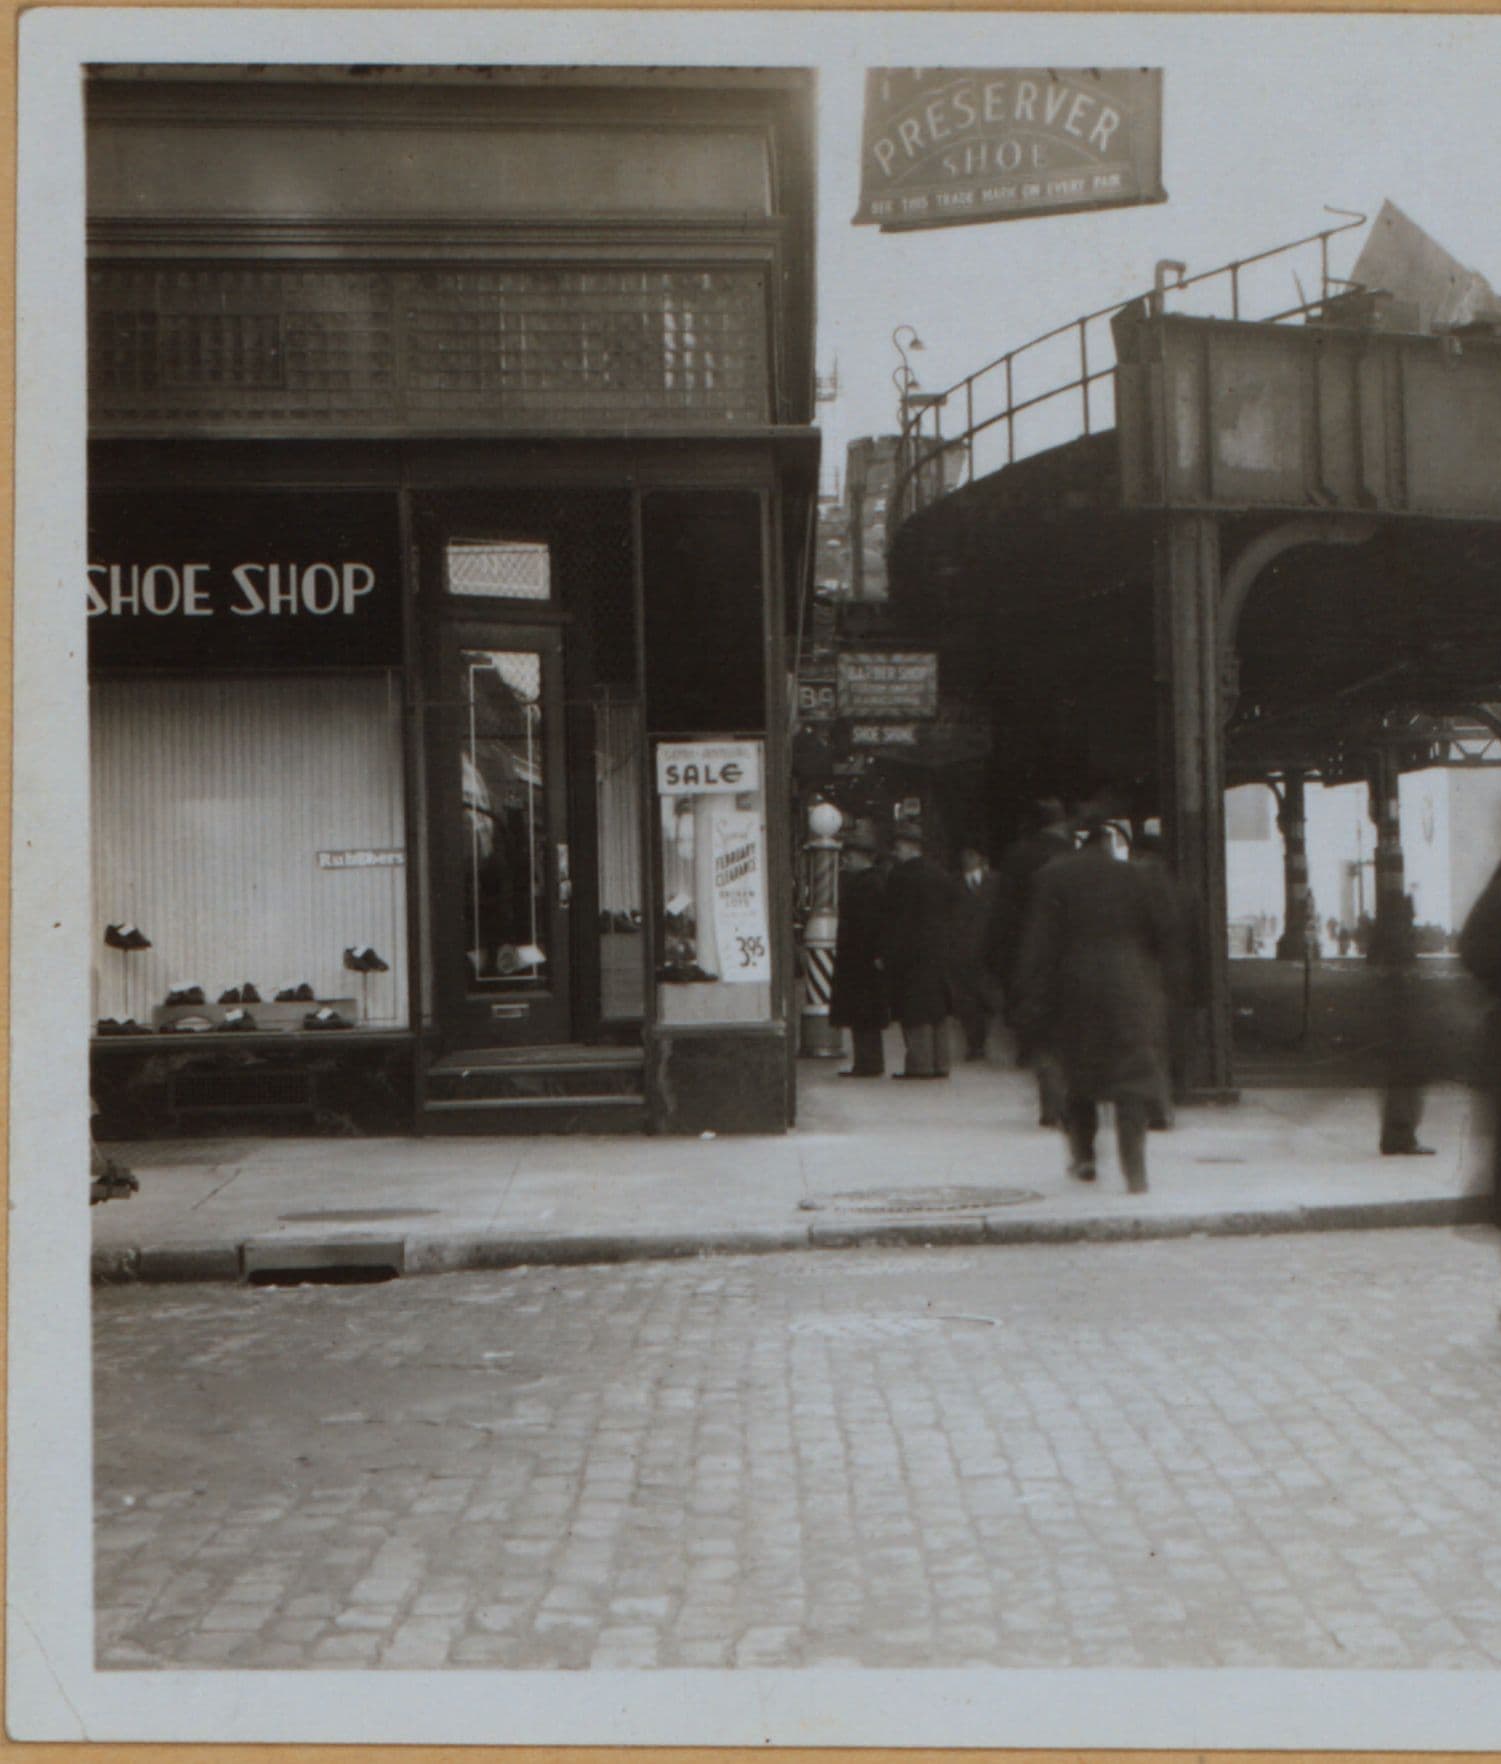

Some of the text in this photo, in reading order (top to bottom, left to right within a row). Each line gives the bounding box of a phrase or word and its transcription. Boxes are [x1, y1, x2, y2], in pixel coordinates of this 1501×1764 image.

[872, 79, 1121, 177] PRESERVER
[942, 140, 1050, 176] SHOE
[901, 195, 929, 211] THIS
[935, 191, 974, 207] TRADE
[981, 186, 1017, 201] MARK
[1022, 183, 1041, 199] ON
[1046, 179, 1086, 196] EVERY
[1093, 173, 1121, 190] PAIR
[86, 562, 376, 617] SHOE SHOP
[666, 763, 744, 786] SALE
